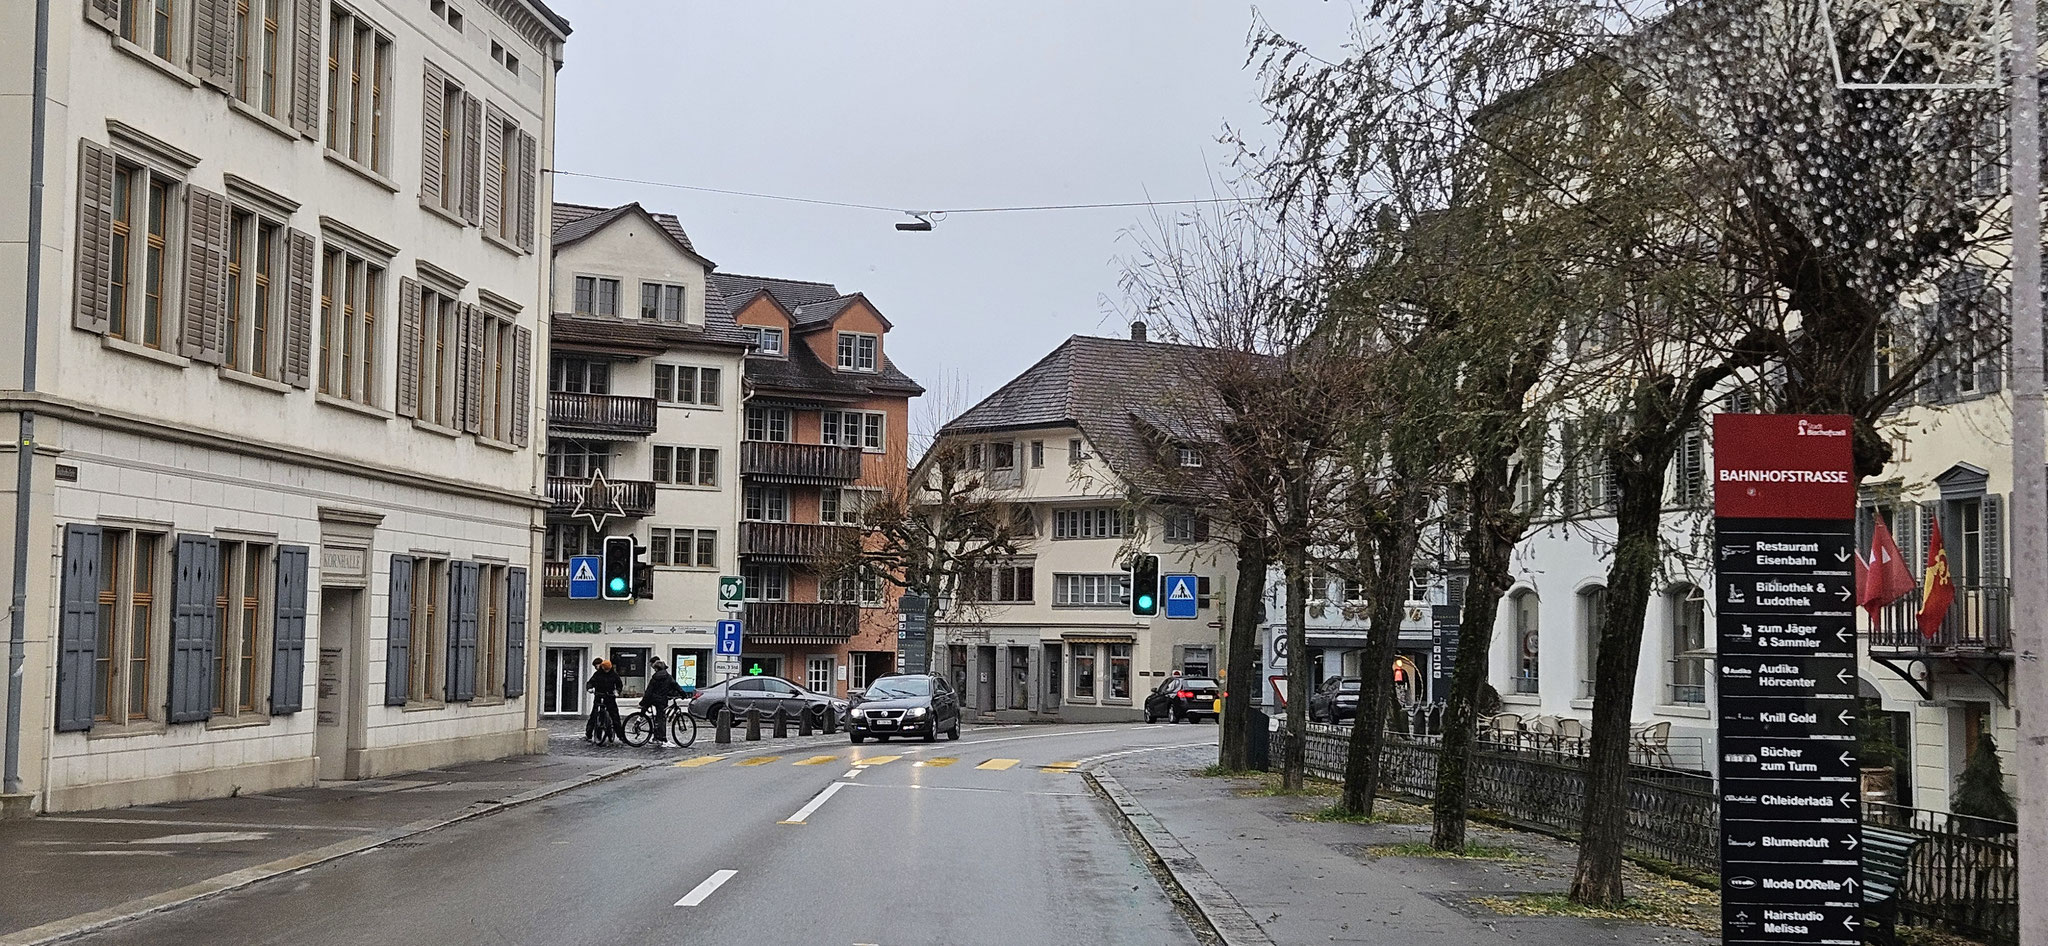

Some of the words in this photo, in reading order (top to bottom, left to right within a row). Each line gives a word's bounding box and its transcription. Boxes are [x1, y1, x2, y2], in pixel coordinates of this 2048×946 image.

[1719, 469, 1848, 483] BAHNHOFSTRASSE
[1756, 541, 1819, 552] Restaurant
[323, 553, 361, 569] KORNHALLE
[1756, 554, 1817, 566] Eisenbahn
[1756, 581, 1814, 593] Bibliothek
[1816, 583, 1827, 593] &
[1756, 596, 1811, 607] Ludothek
[724, 623, 735, 640] P
[1757, 625, 1783, 633] zum
[1784, 623, 1818, 636] Jäger
[1758, 636, 1768, 647] &
[1769, 636, 1822, 648] Sammler
[1758, 663, 1799, 674] Audika
[1758, 676, 1817, 688] Hörcenter
[1759, 712, 1787, 723] Knill
[1788, 713, 1817, 724] Gold
[1760, 746, 1803, 758] Bücher
[1760, 763, 1786, 771] zum
[1787, 761, 1818, 772] Turm
[1760, 794, 1834, 807] Chleiderladä
[1762, 836, 1830, 848] Blumenduft
[1762, 878, 1795, 890] Mode
[1795, 879, 1841, 891] DORelle
[1763, 909, 1825, 922] Hairstudio
[1764, 922, 1809, 934] Melissa
